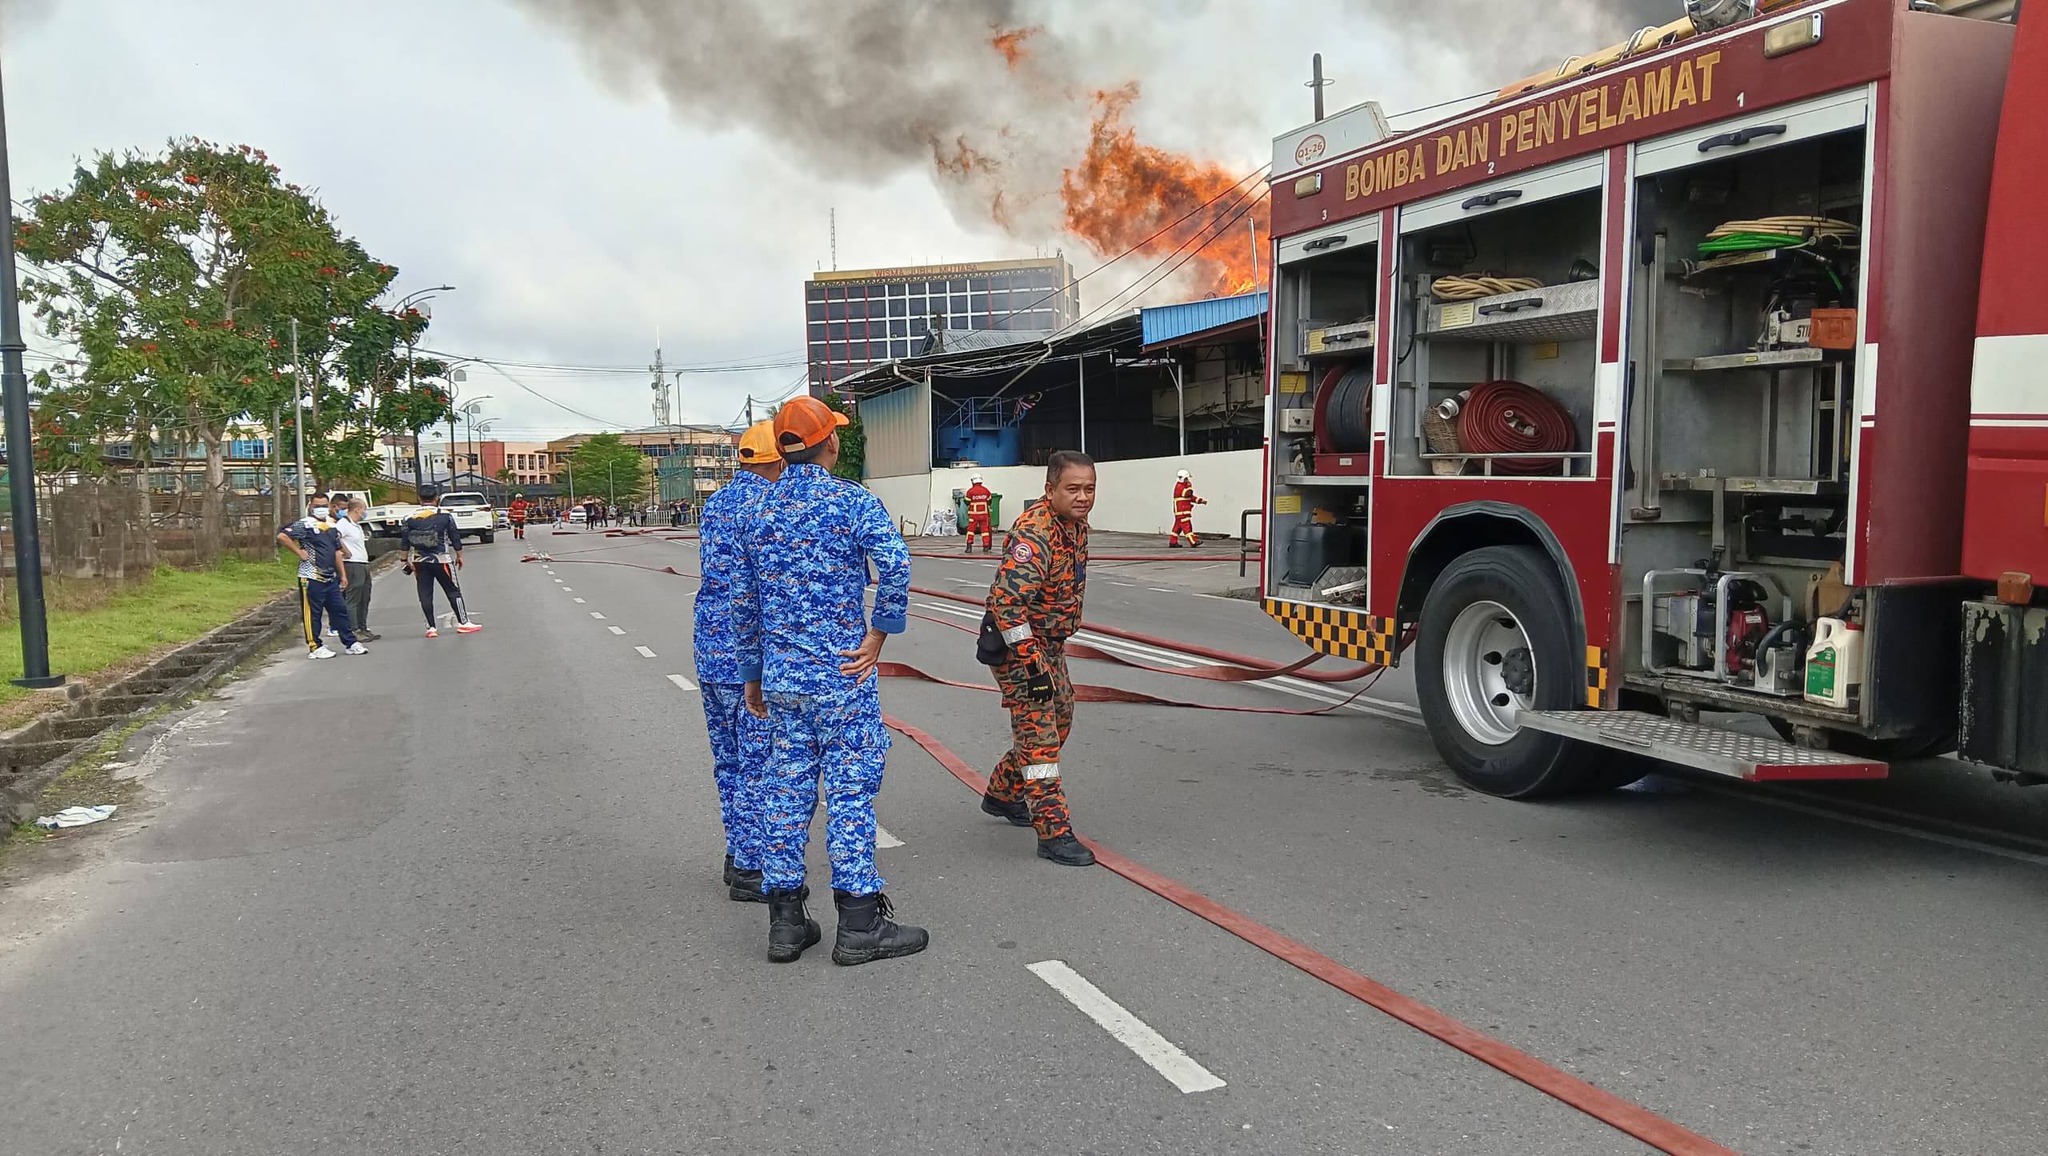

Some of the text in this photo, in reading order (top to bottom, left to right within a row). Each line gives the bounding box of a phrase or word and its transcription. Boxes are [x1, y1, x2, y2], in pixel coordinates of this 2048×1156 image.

[1736, 91, 1745, 108] 1
[1345, 50, 1721, 202] BOMBA DAN PENYELAMAT
[1487, 161, 1496, 175] 2
[1321, 208, 1328, 221] 3
[874, 268, 904, 277] WISMA
[940, 263, 979, 273] MUTIARA
[1796, 324, 1811, 338] STI
